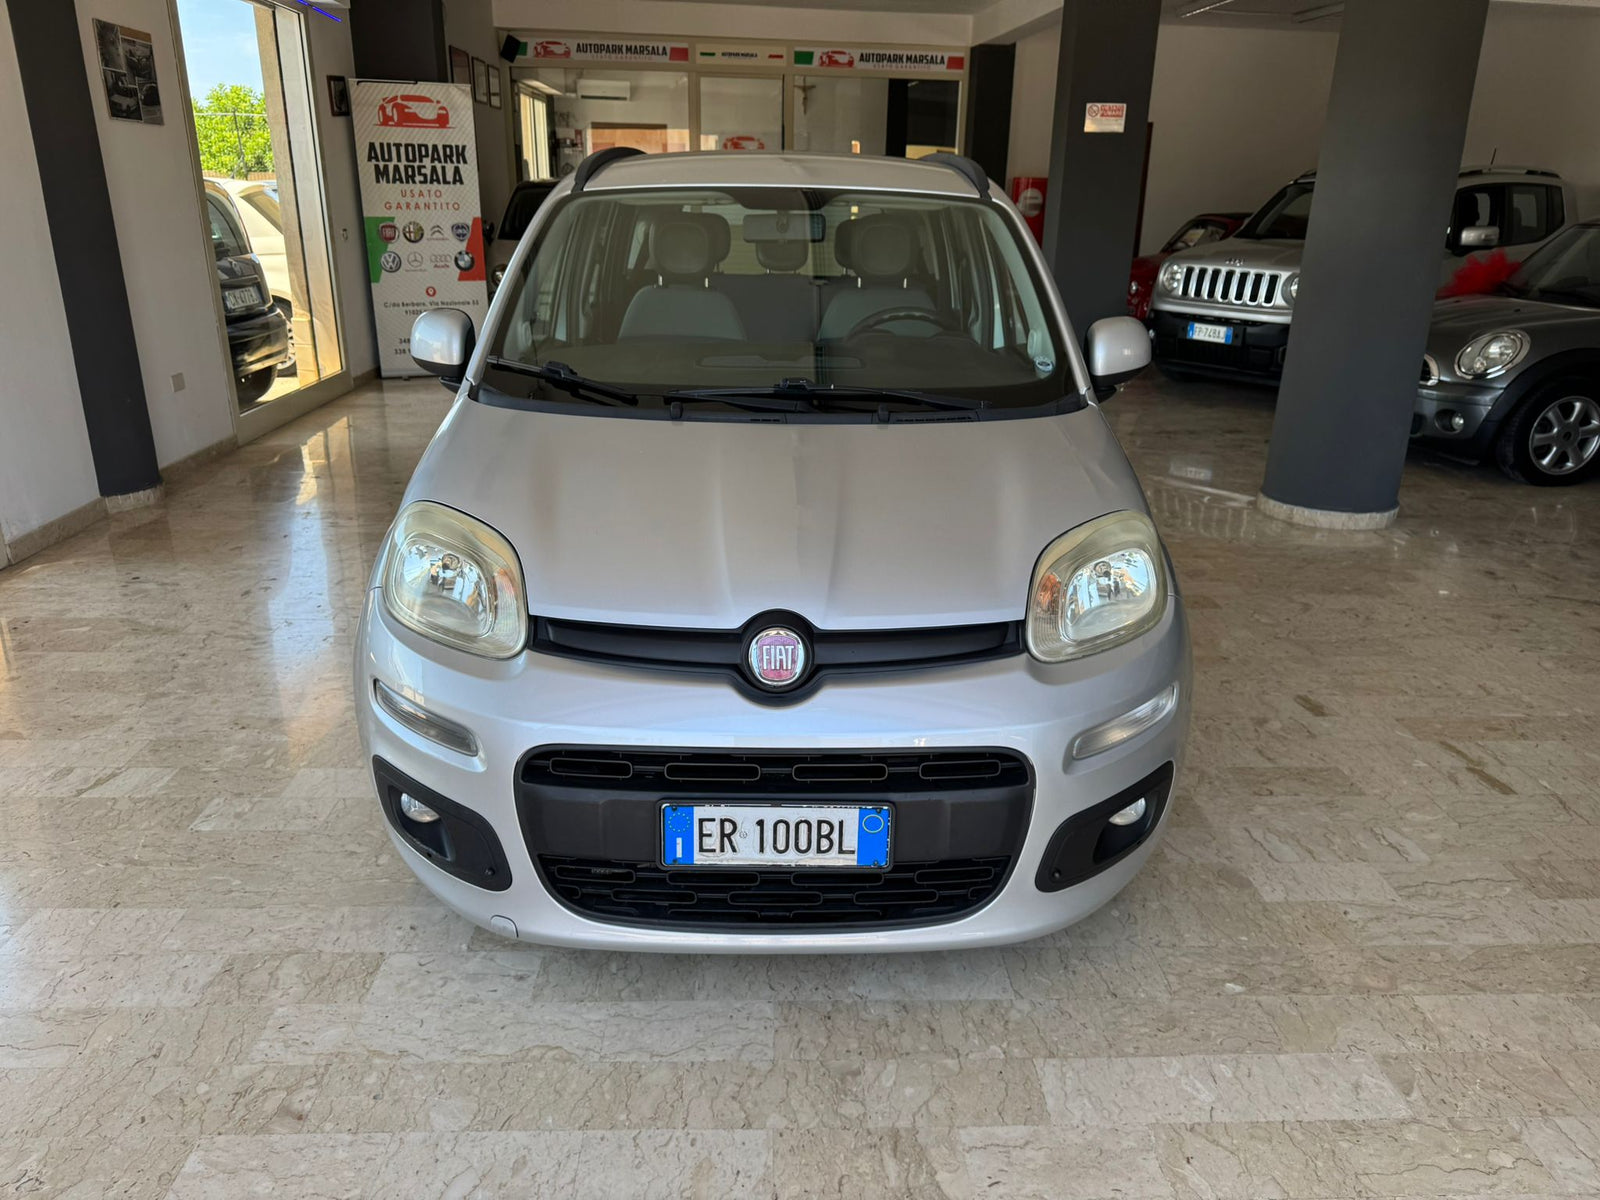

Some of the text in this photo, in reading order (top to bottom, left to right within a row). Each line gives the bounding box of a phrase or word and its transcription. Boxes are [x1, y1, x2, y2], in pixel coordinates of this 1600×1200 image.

[576, 42, 668, 57] AUTOPARK MARSALA
[859, 52, 945, 65] AUTOPARK MARSALA
[367, 142, 468, 164] AUTOPARK
[374, 164, 464, 185] MARSALA
[400, 189, 443, 199] USATO
[384, 201, 461, 211] GARANTITO
[762, 645, 794, 670] FIAT
[698, 817, 856, 854] ER 100BL
